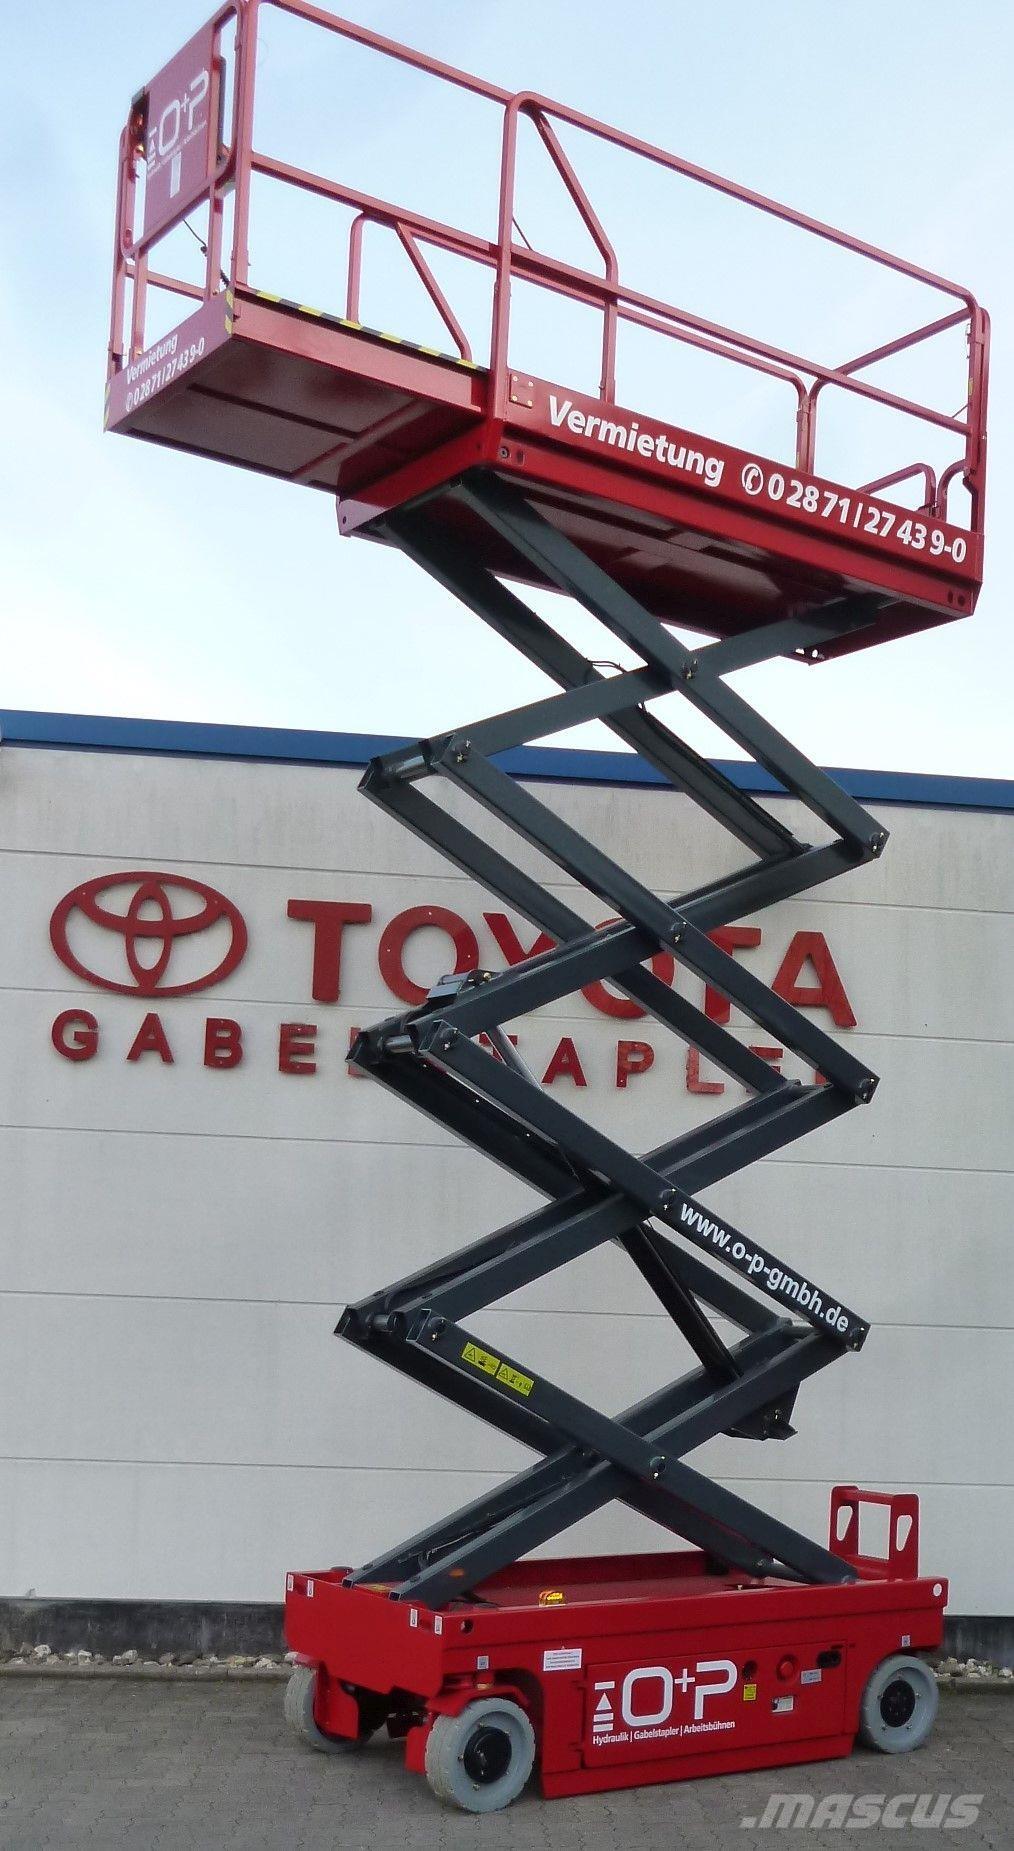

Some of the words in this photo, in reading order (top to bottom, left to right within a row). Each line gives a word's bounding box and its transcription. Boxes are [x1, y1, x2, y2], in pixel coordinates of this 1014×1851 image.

[127, 334, 178, 385] Vermietung
[548, 395, 725, 487] Vermietung
[680, 1202, 850, 1334] www.o-p-gmbh.de
[622, 1659, 738, 1727] O+P
[592, 1731, 629, 1747] Hydraulik
[633, 1726, 680, 1741] Gabelstapler
[683, 1720, 736, 1734] Arbeitsbühnen
